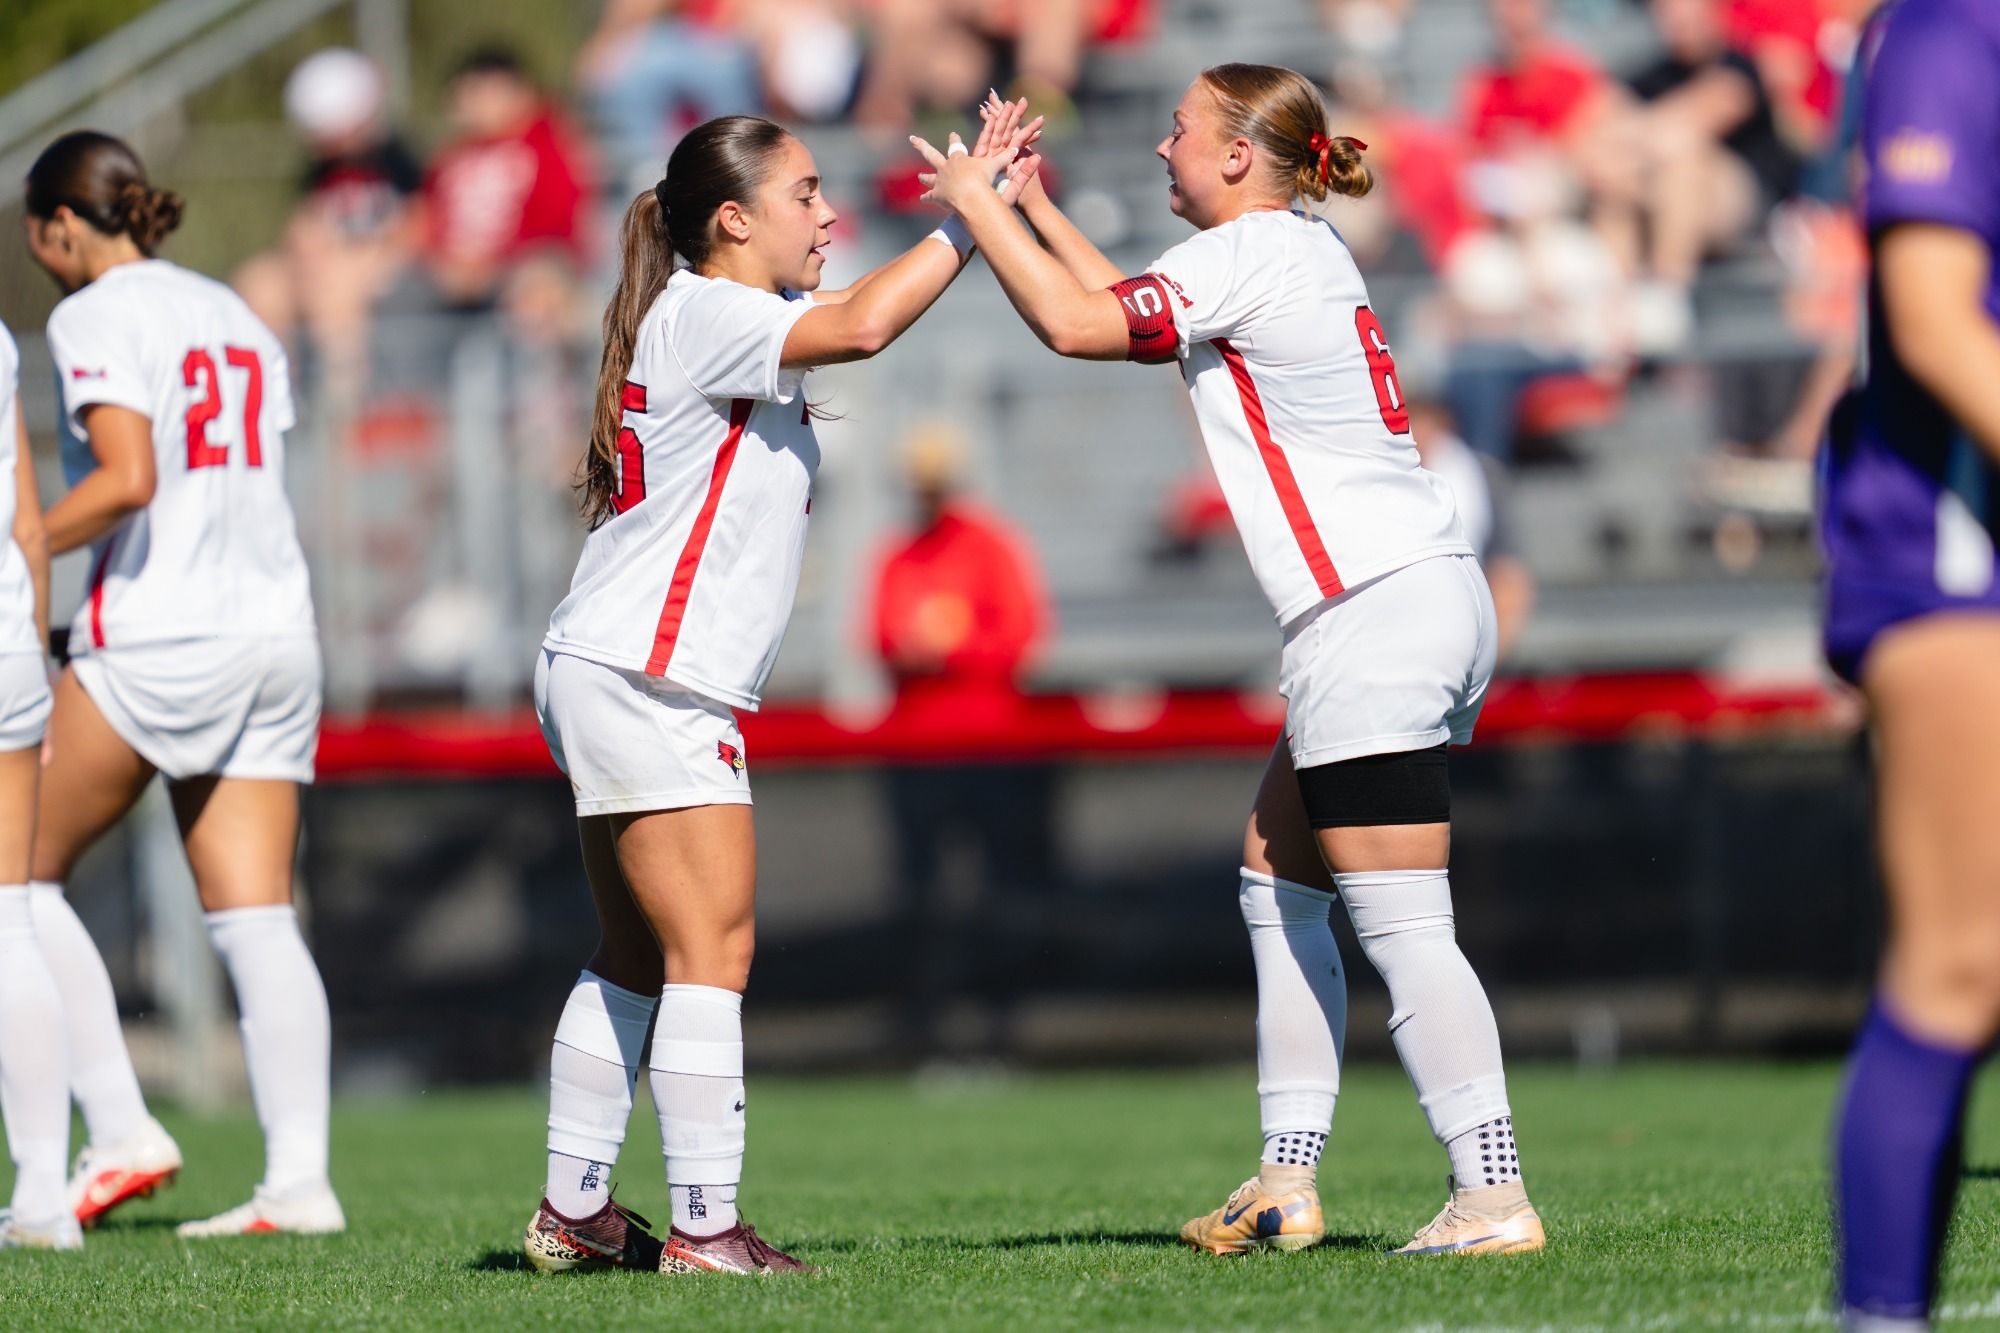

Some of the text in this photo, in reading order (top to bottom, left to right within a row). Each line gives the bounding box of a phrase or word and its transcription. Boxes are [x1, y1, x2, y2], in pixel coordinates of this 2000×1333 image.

[1133, 286, 1163, 317] C
[182, 345, 262, 470] 27
[1355, 305, 1410, 435] 6
